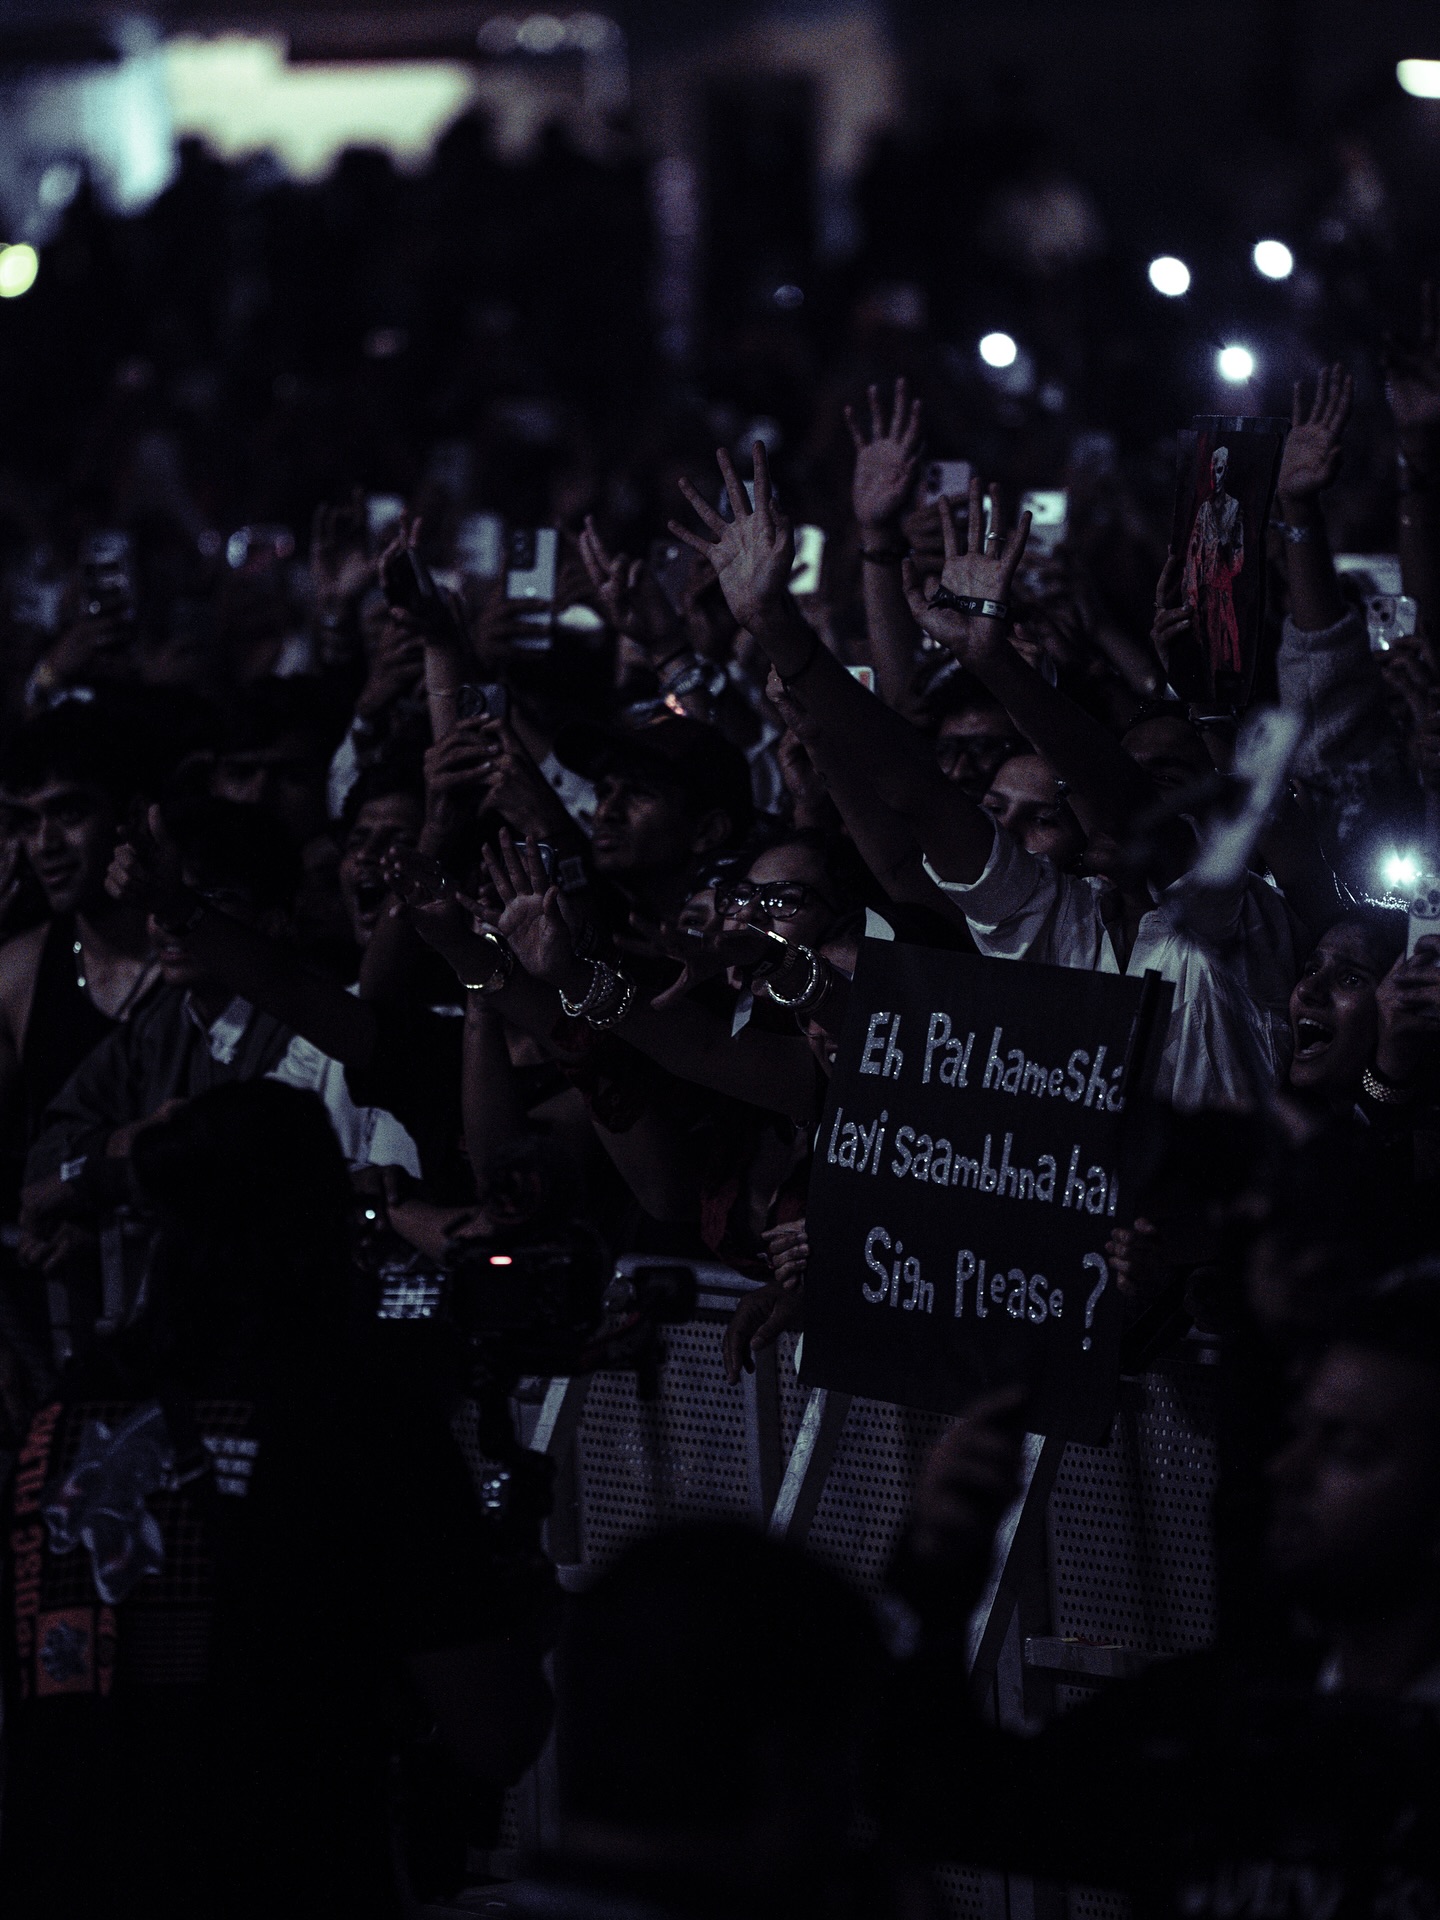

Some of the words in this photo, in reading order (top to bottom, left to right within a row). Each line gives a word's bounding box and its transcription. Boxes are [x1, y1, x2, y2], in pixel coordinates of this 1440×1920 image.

[859, 1011, 905, 1080] Eh
[921, 1011, 977, 1089] Pal
[826, 1107, 889, 1176] layi
[890, 1125, 1058, 1203] saambhna
[861, 1226, 935, 1314] Sign
[953, 1249, 1064, 1325] Please
[1081, 1252, 1110, 1352] ?
